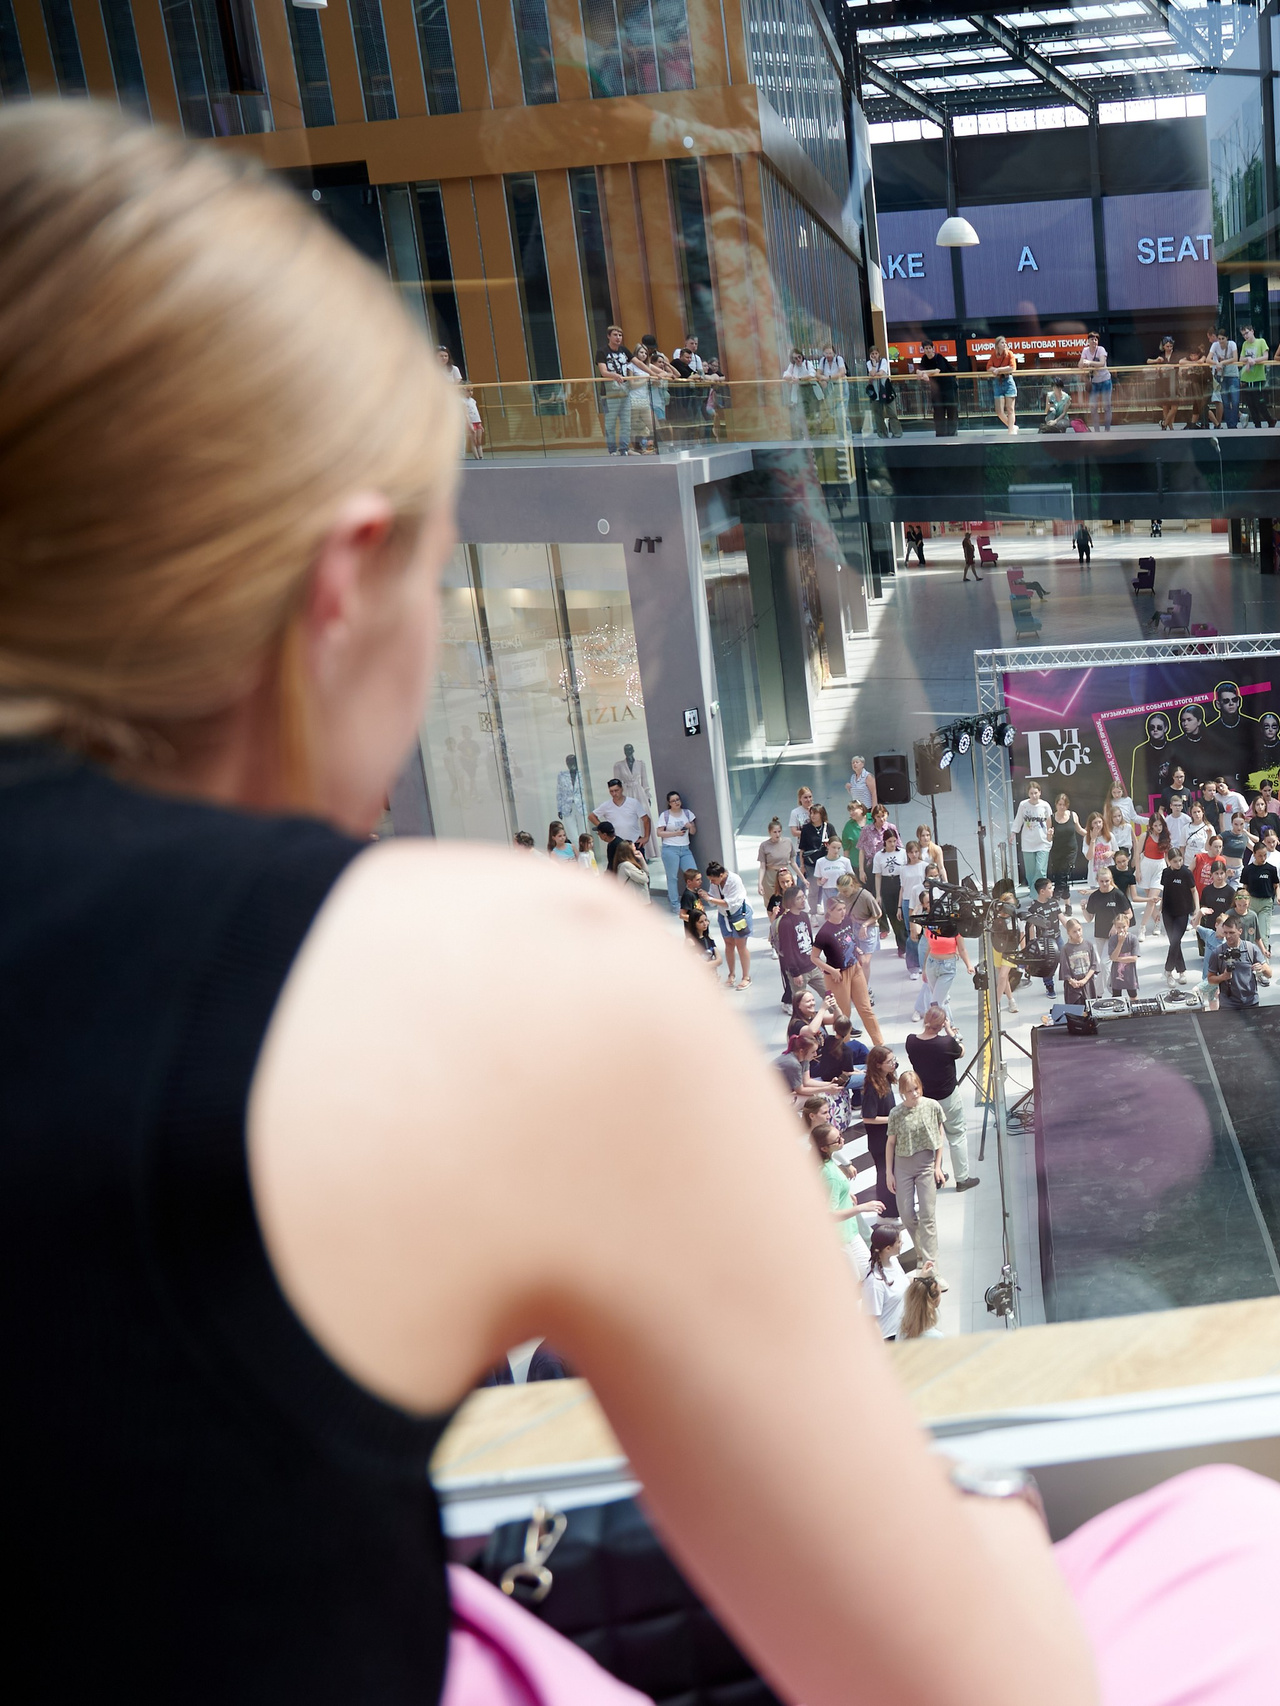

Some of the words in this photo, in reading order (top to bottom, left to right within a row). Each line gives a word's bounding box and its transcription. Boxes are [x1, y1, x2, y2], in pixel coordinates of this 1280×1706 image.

[1017, 246, 1038, 272] A
[1136, 234, 1212, 265] SEAT
[1014, 341, 1020, 349] И
[1021, 340, 1057, 350] БЫТОВАЯ
[1100, 704, 1145, 719] МУЗЫКАЛЬНОЕ
[1146, 700, 1174, 711] СОБЫТИЕ
[1174, 697, 1193, 706] ЭТОГО
[1193, 694, 1209, 703] ЛЕТА
